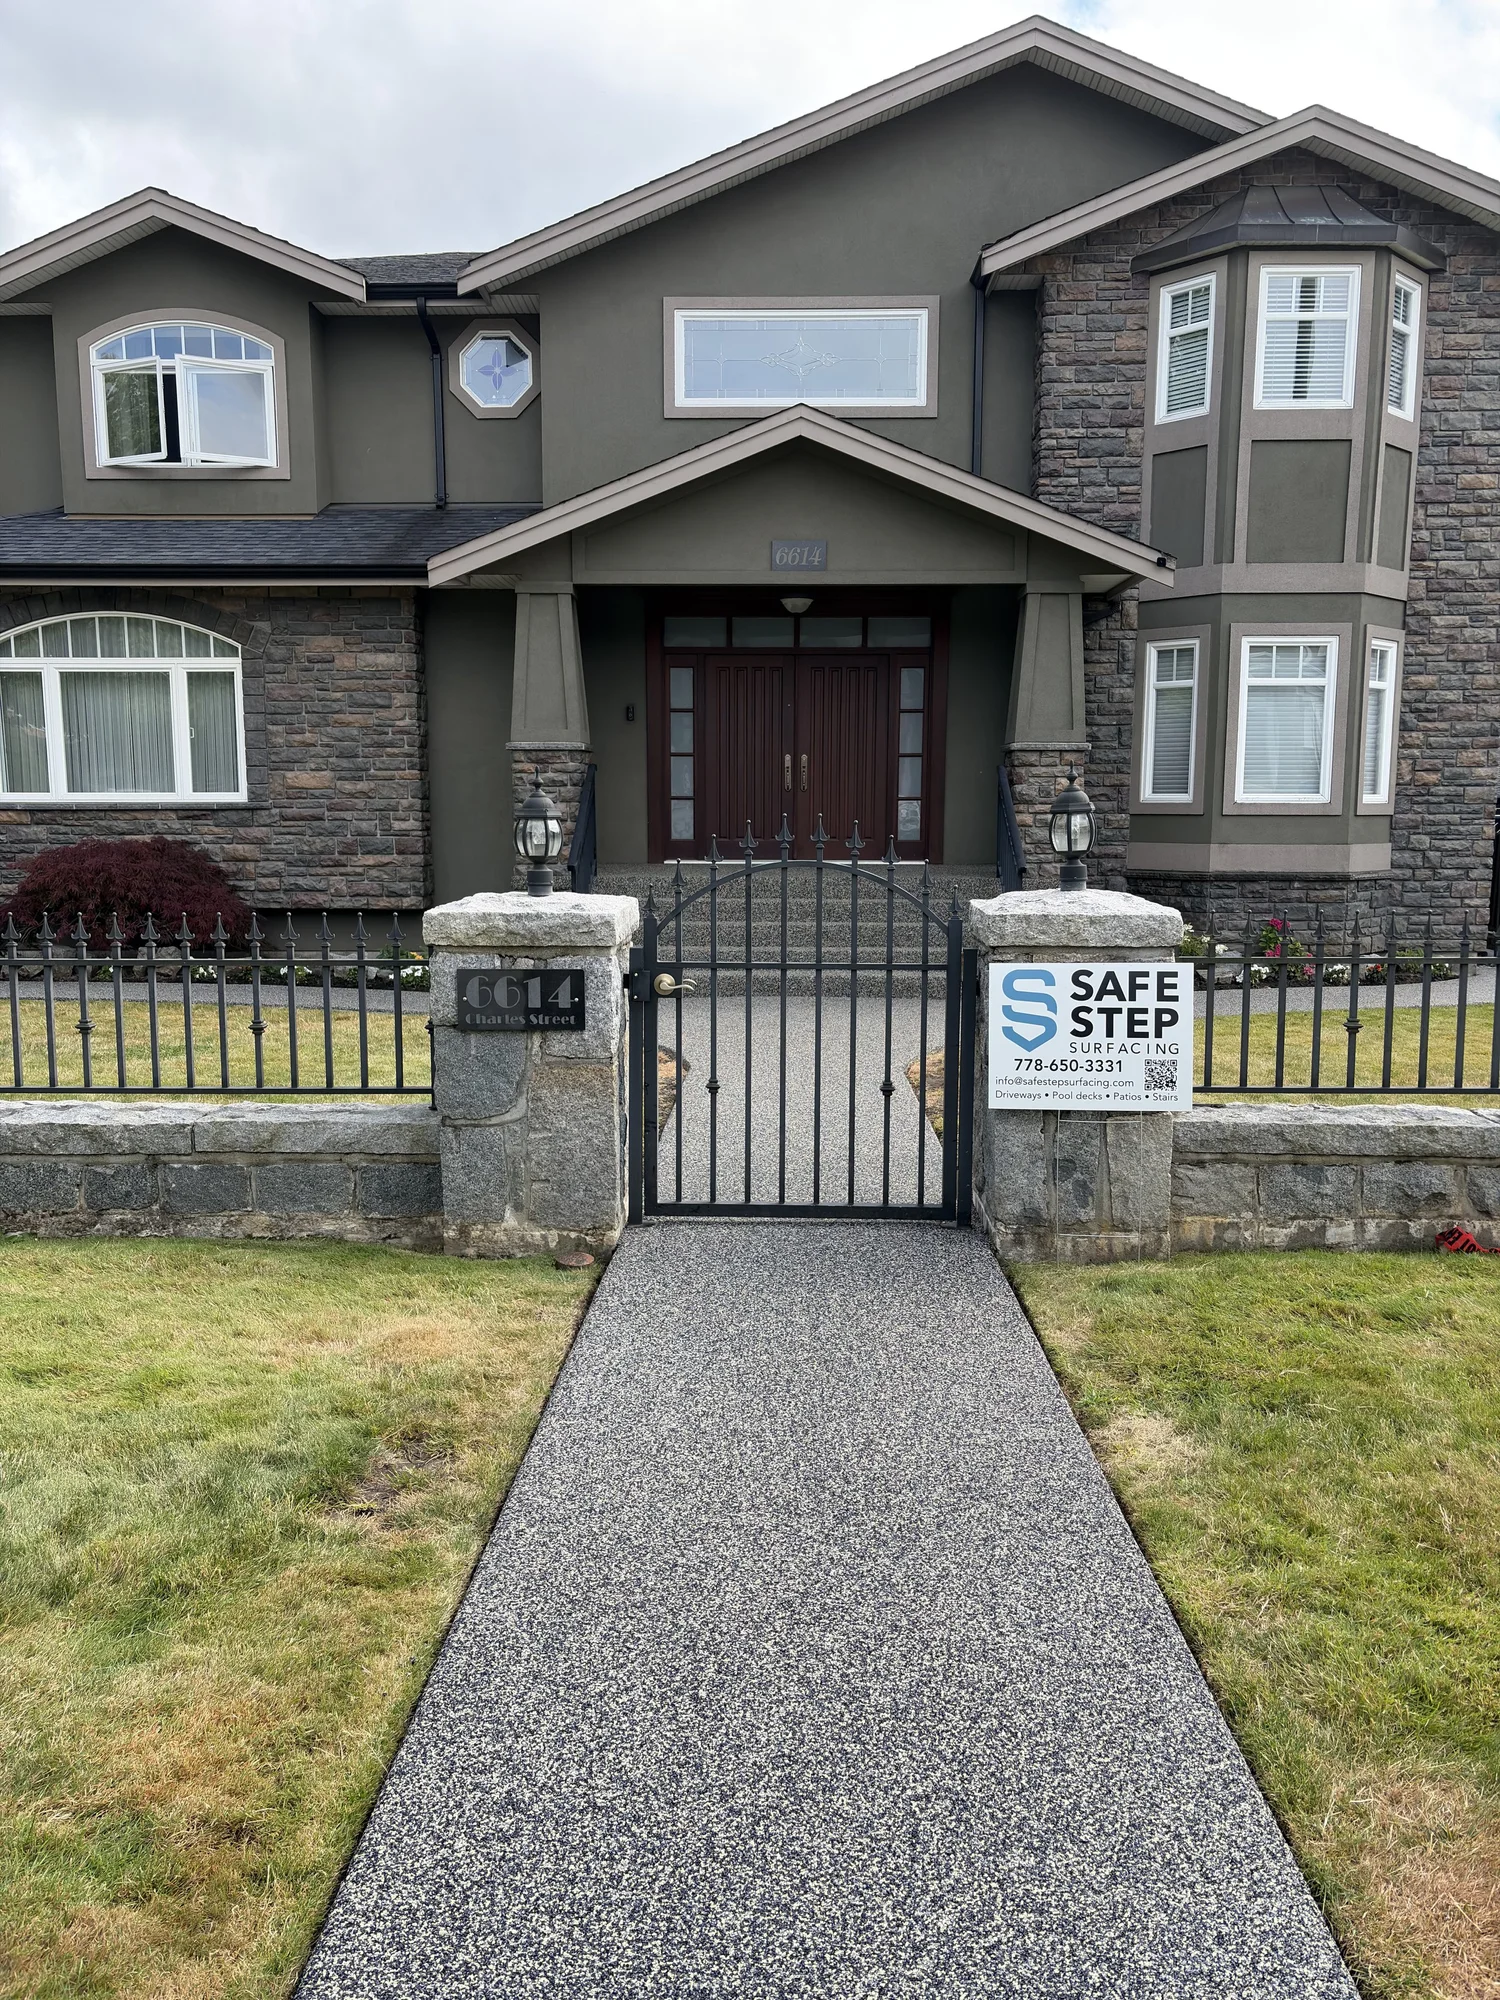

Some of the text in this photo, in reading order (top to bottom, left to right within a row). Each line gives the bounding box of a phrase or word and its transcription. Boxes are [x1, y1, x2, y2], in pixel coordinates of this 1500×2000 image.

[775, 546, 822, 566] 6614
[465, 975, 575, 1009] 6614
[1069, 969, 1179, 1002] SAFE
[465, 1013, 577, 1025] Charles Street
[1069, 1005, 1179, 1039] STEP
[1069, 1041, 1179, 1055] SURFACING
[1014, 1058, 1123, 1073] 778-650-3331
[995, 1076, 1135, 1089] info@safestepsurfacing.com
[995, 1090, 1179, 1102] Driveways Pool decks Patios Stairs
